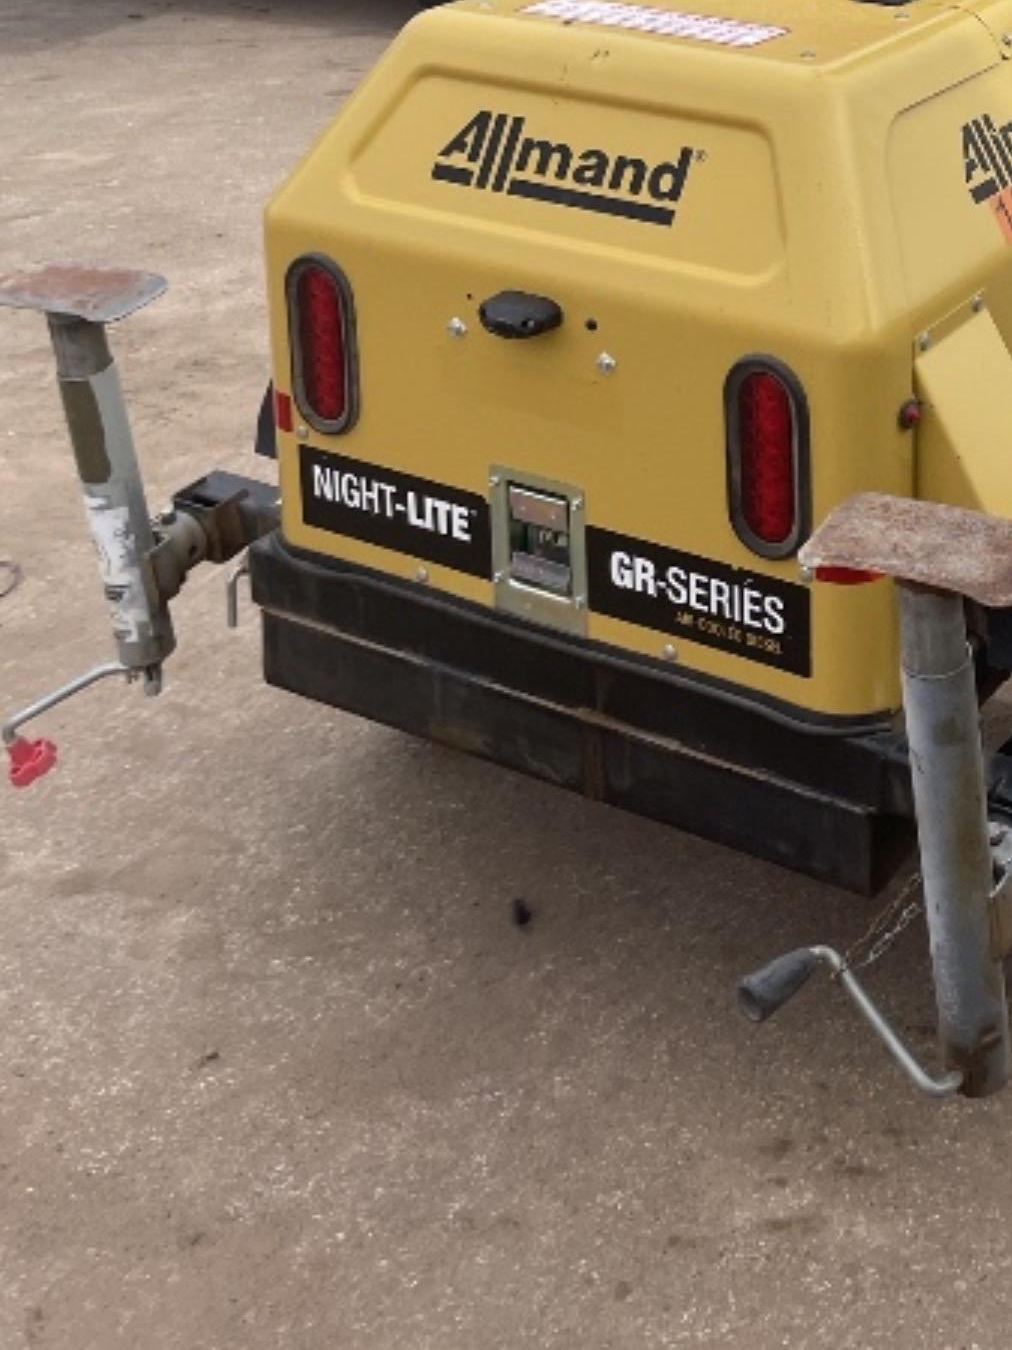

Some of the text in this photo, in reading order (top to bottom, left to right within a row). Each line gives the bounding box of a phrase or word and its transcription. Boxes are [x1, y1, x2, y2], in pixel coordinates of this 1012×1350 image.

[435, 110, 695, 203] Allmand
[313, 464, 472, 542] NIGHT-LITE
[610, 551, 785, 635] GR-SERIES
